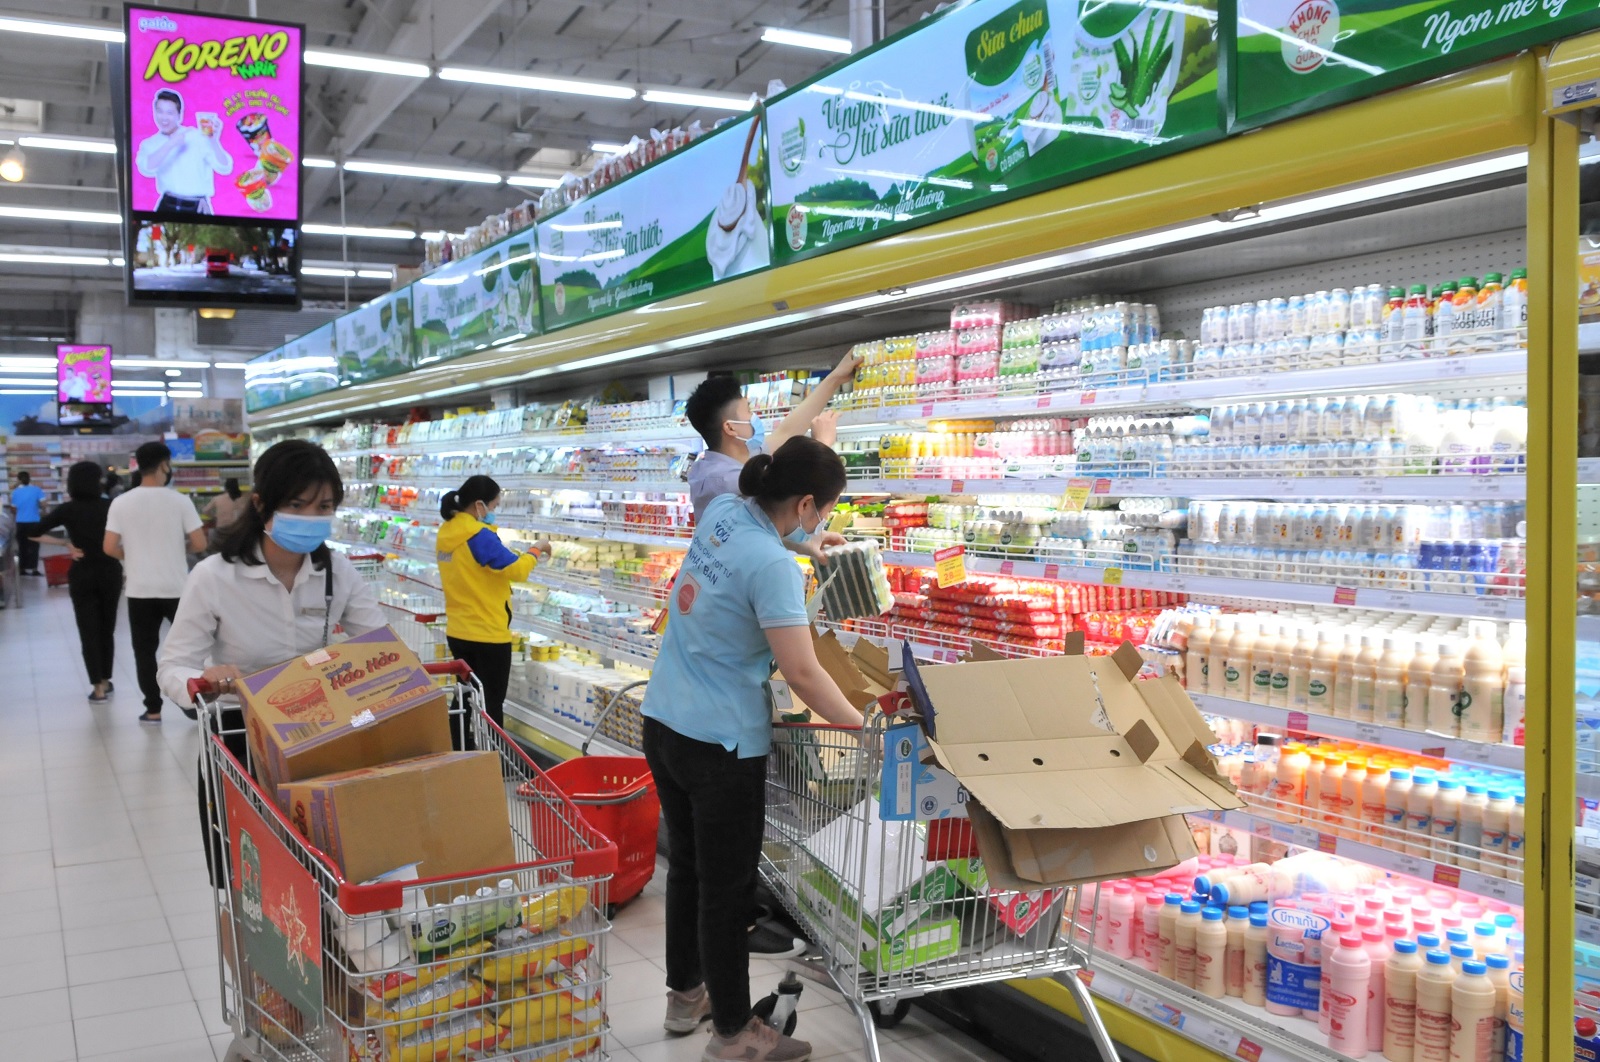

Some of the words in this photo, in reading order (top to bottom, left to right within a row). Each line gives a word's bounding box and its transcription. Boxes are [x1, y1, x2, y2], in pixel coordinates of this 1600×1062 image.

[1289, 4, 1331, 33] KHÔNG
[1422, 11, 1494, 54] Ngon
[143, 30, 289, 82] KORENO
[365, 651, 401, 673] Hảo
